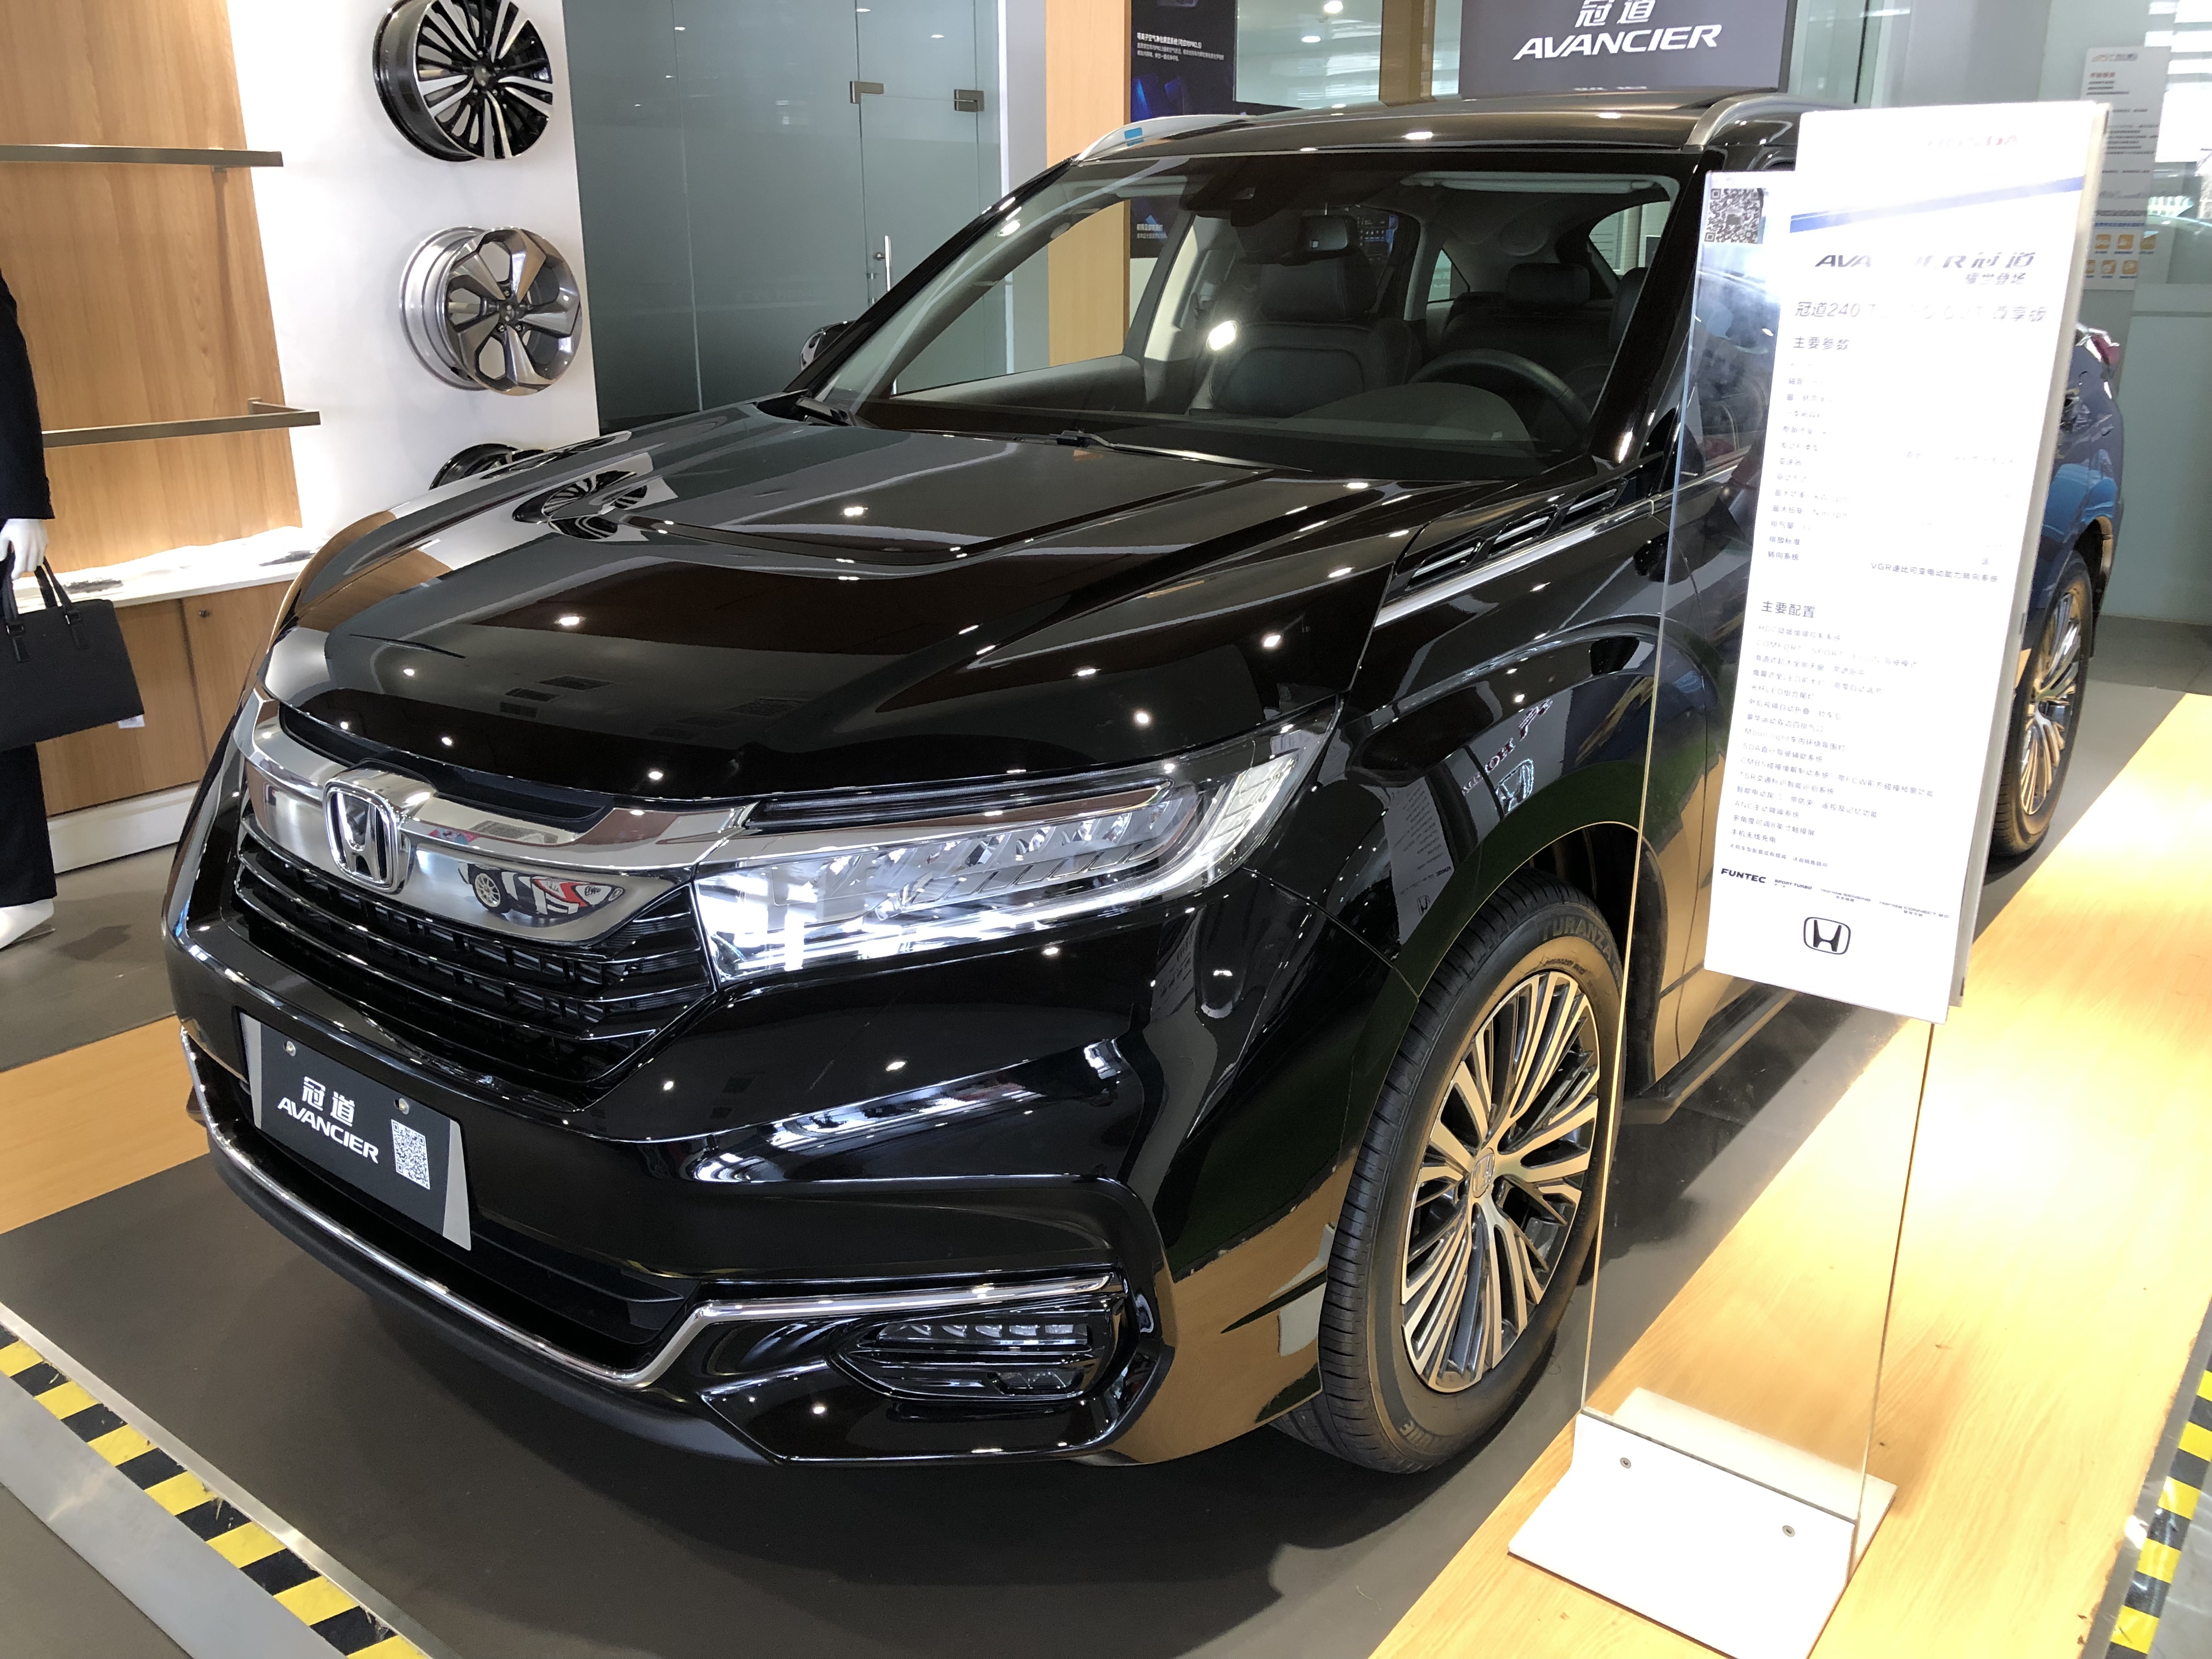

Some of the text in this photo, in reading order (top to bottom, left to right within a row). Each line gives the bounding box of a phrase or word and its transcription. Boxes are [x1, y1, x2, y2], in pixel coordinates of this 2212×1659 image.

[1575, 0, 1656, 28] 冠道
[1512, 24, 1723, 61] AVANCIER
[1793, 336, 1850, 350] 主要参数
[1769, 535, 1801, 546] 排放标准
[1768, 550, 1799, 561] 转向系统
[1760, 600, 1815, 618] 主要配置
[1731, 828, 1776, 843] 手机无线充电
[1720, 867, 1767, 884] FUNTEC
[1774, 878, 1793, 887] SPORT
[1793, 882, 1813, 890] TURBO
[301, 1076, 356, 1127] 冠道
[276, 1097, 380, 1164] AVANCIER
